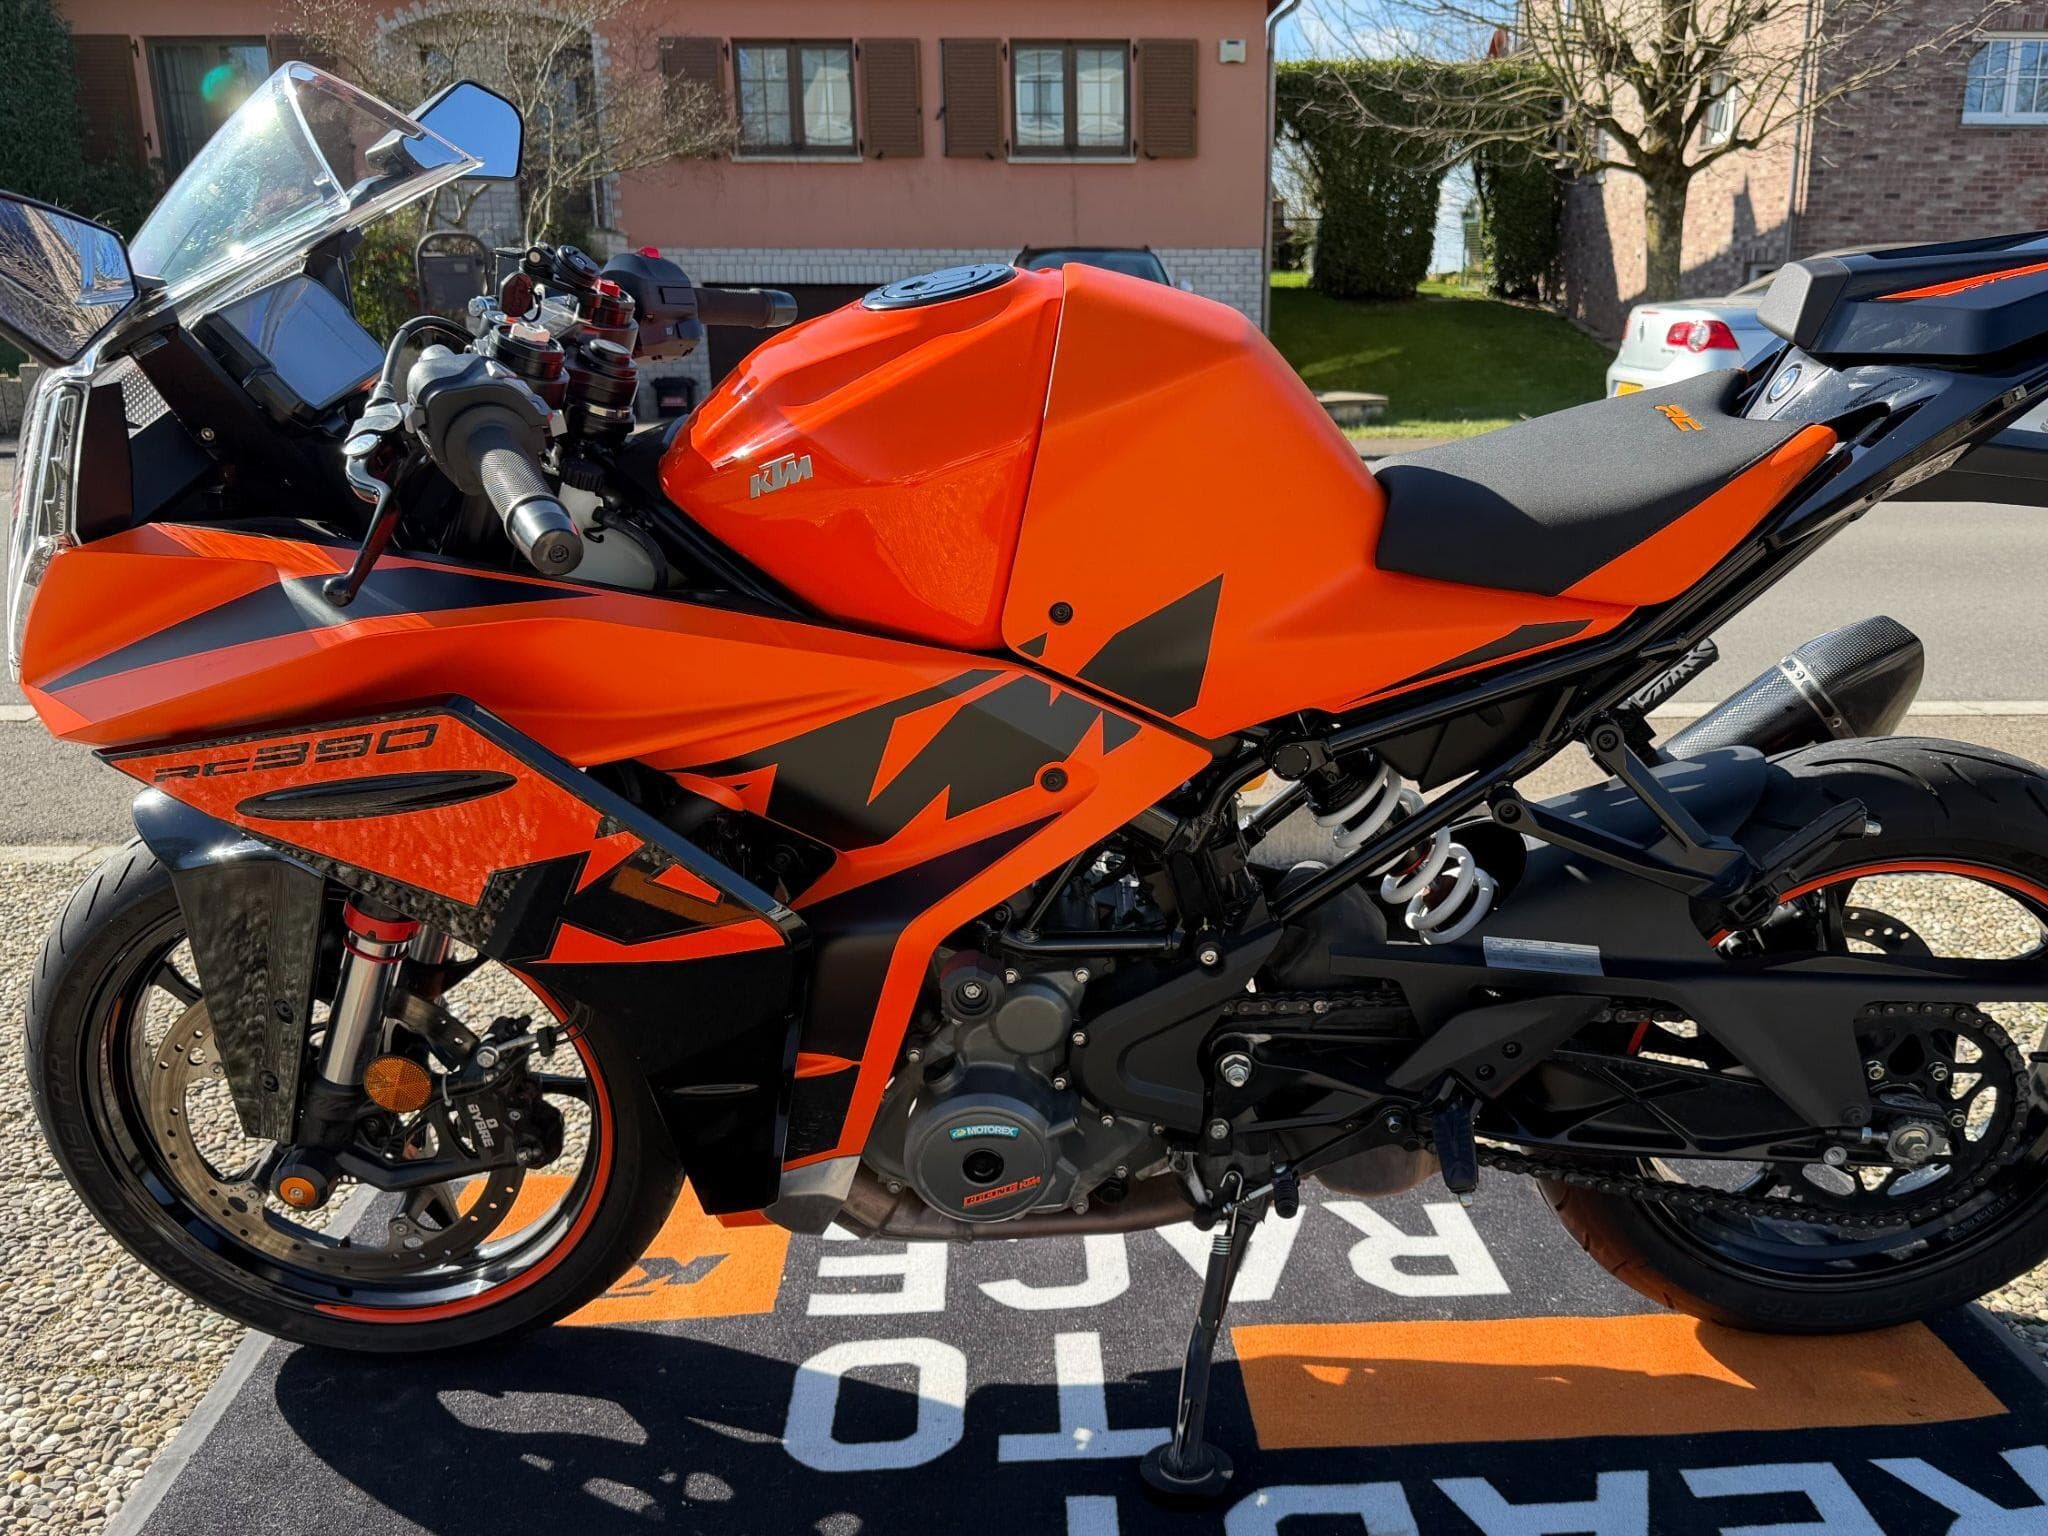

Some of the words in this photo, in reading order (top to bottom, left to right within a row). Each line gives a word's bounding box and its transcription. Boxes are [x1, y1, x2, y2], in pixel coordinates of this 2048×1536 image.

[750, 453, 813, 499] KTM
[467, 1104, 494, 1147] BYBRE
[967, 1125, 1019, 1137] MOTOREX
[807, 1201, 1512, 1315] RACE
[784, 1332, 1174, 1472] TO
